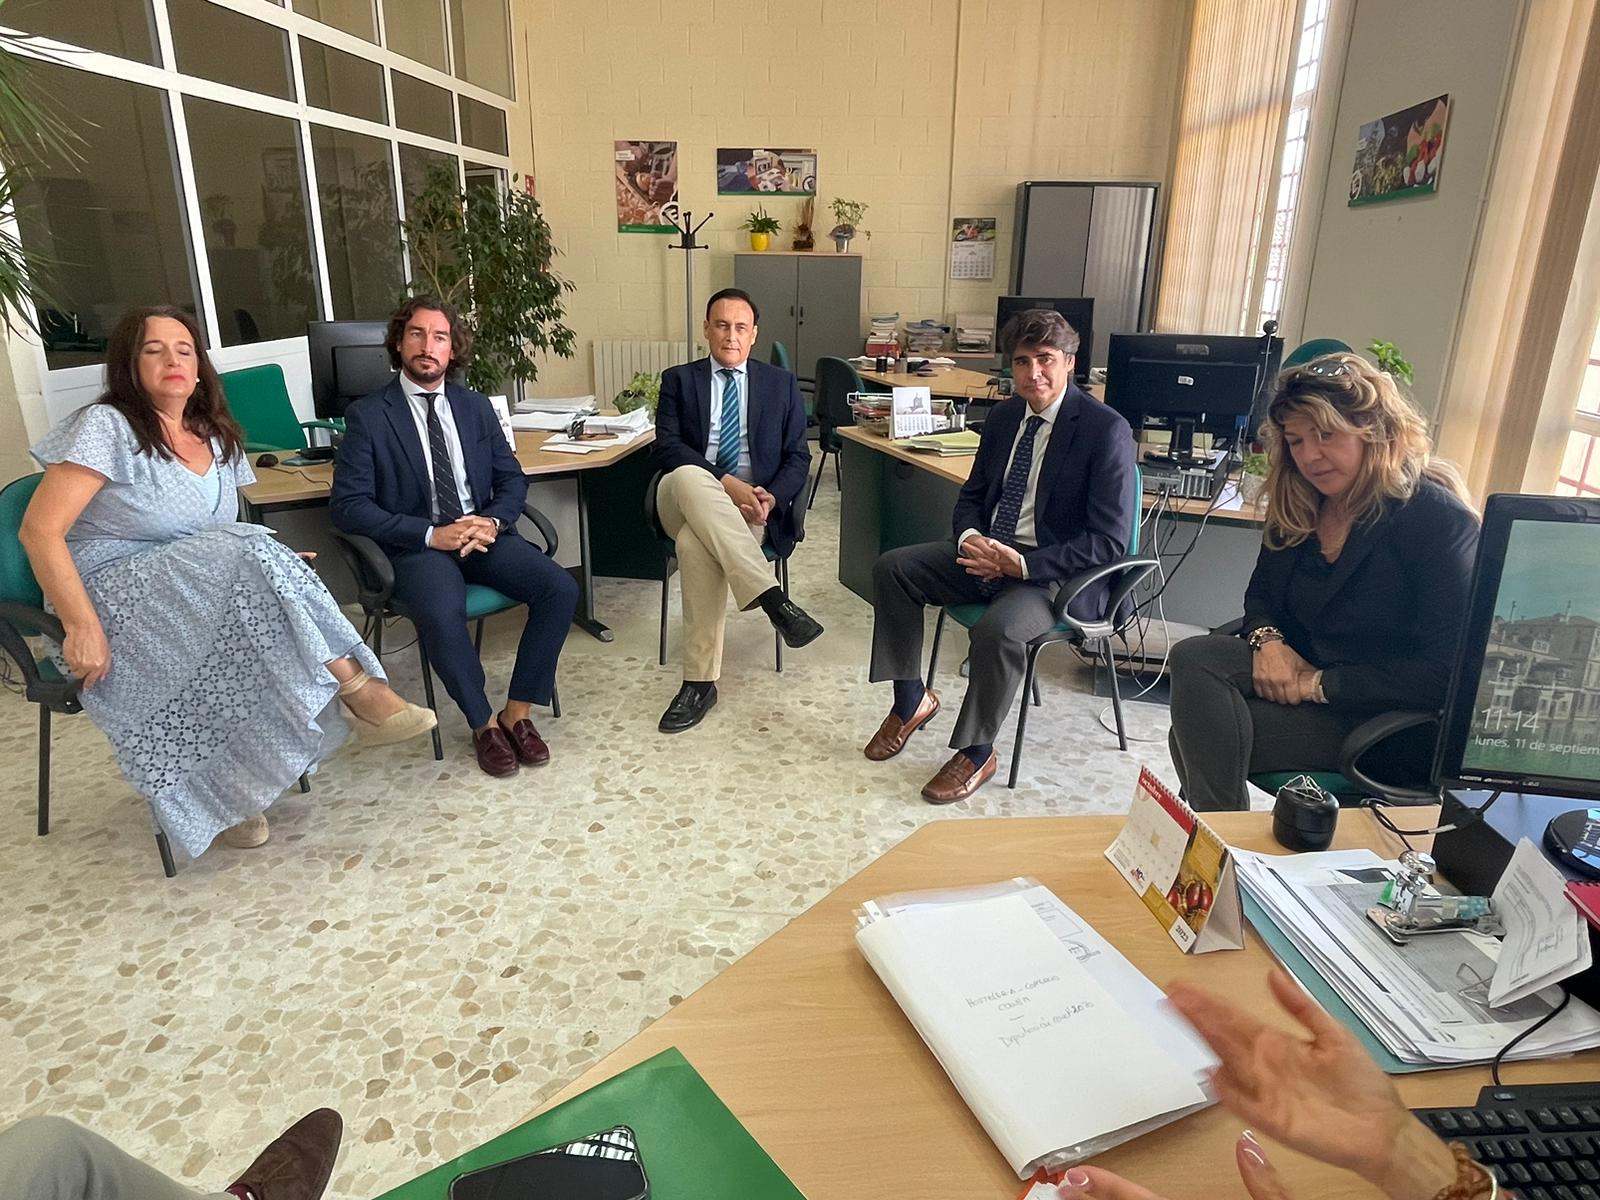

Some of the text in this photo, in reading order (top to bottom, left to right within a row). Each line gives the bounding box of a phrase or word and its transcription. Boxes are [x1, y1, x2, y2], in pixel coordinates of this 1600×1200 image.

[1481, 708, 1540, 734] 11:14
[1474, 735, 1510, 749] lunes,
[1515, 738, 1527, 749] 11
[1529, 740, 1546, 752] de
[1175, 924, 1189, 943] 2023
